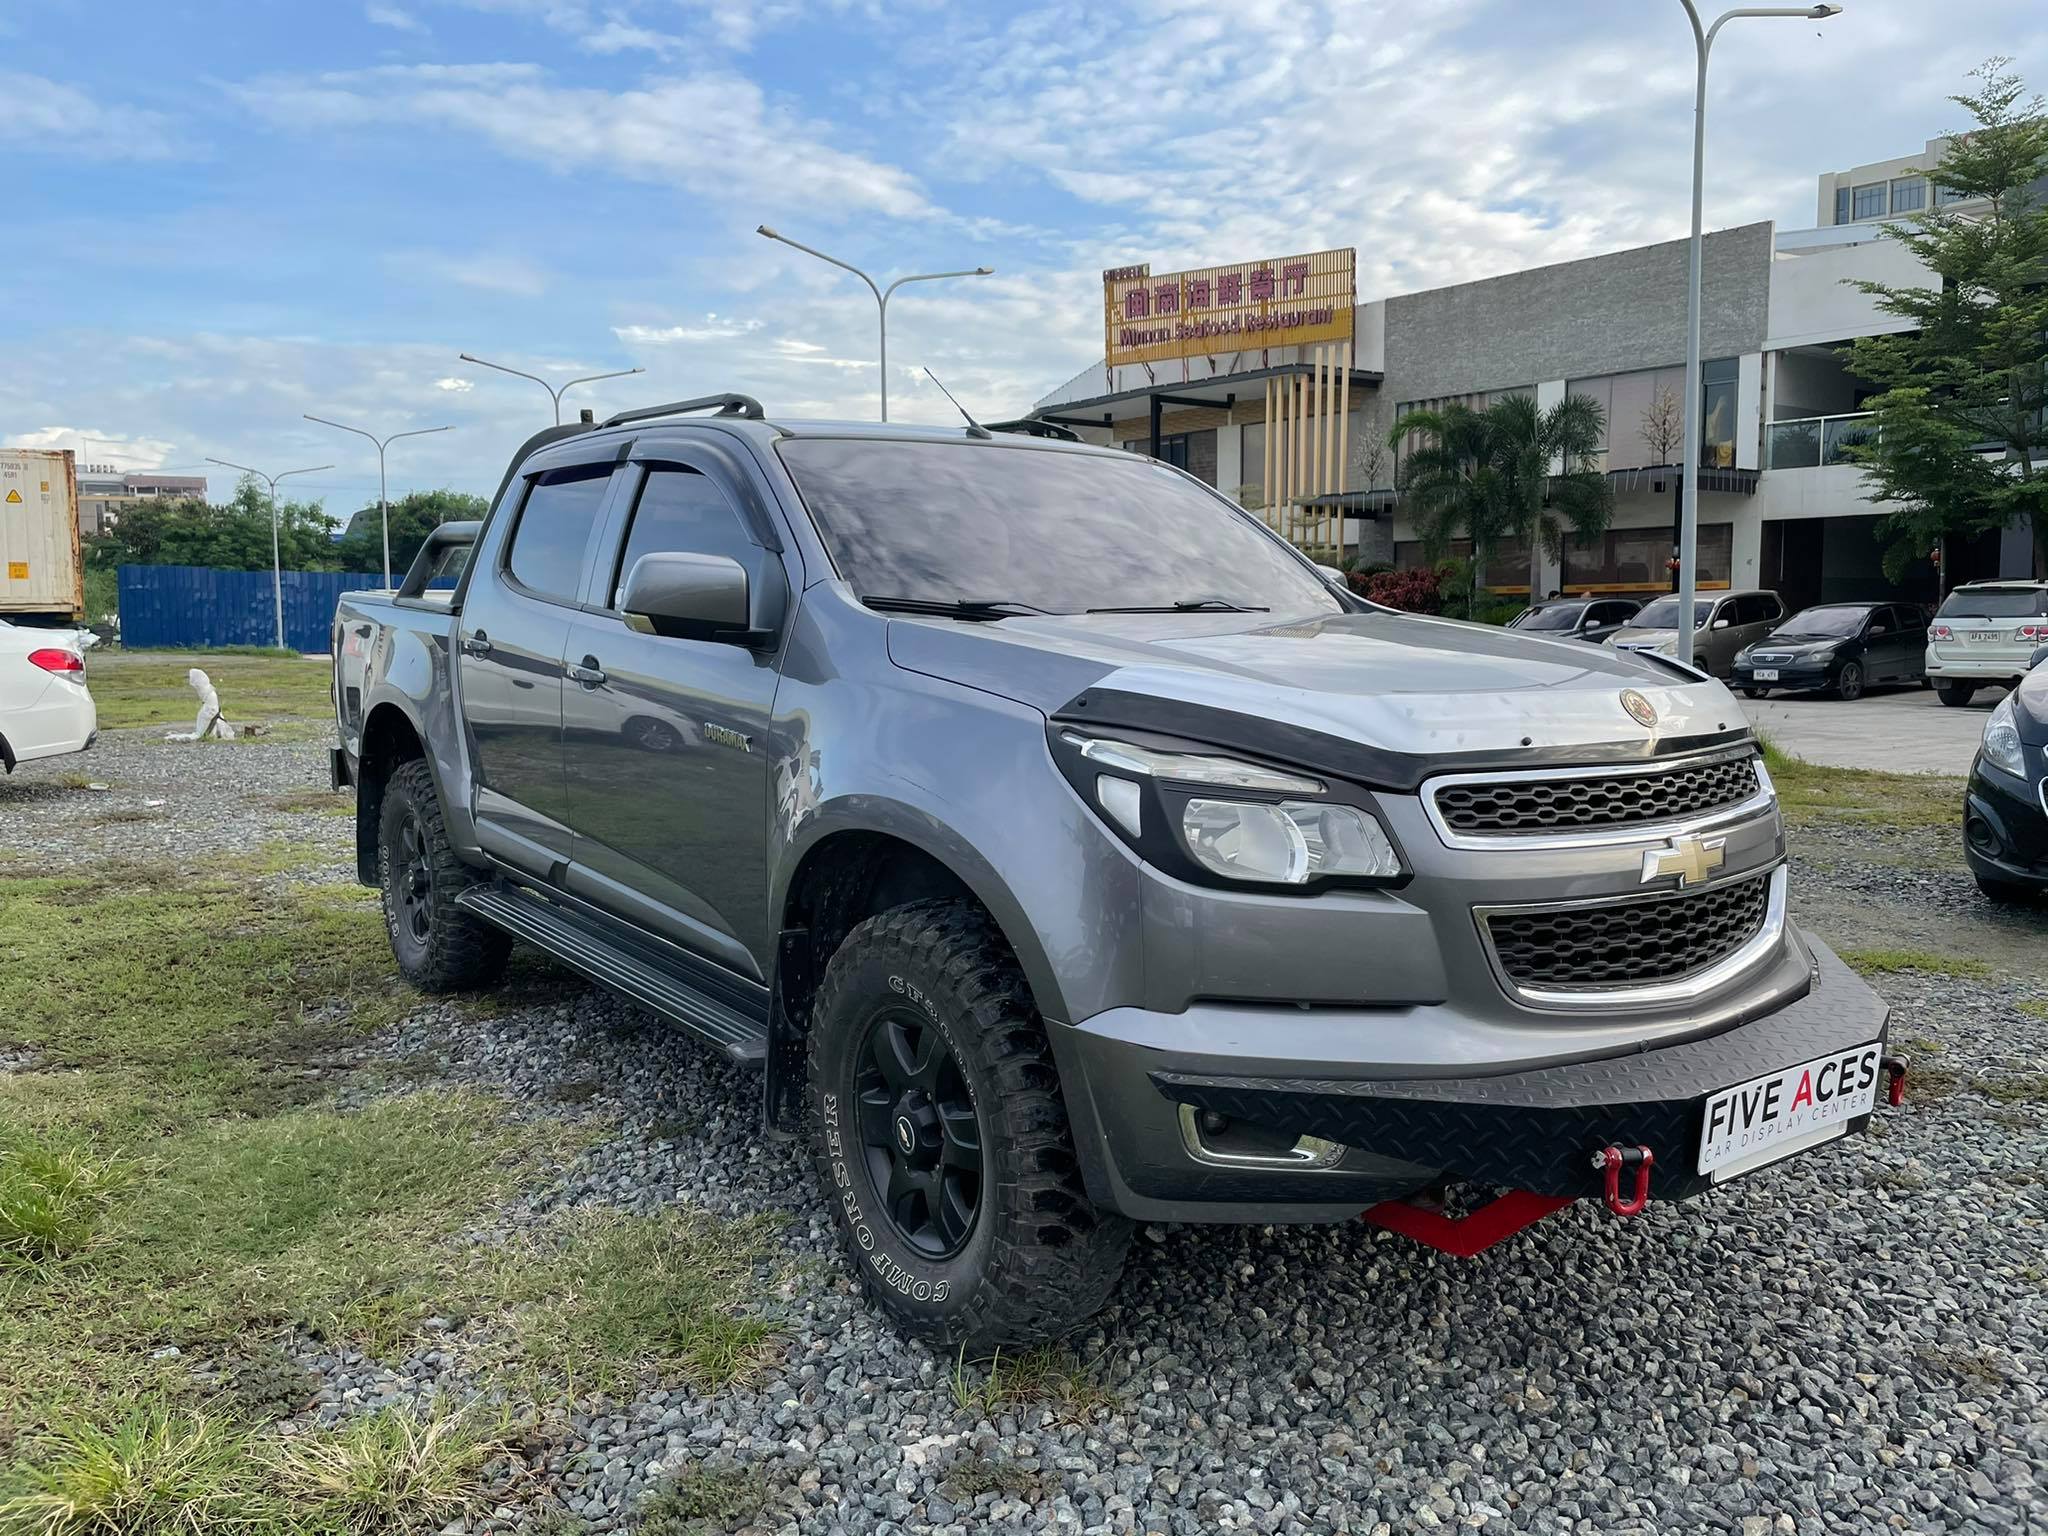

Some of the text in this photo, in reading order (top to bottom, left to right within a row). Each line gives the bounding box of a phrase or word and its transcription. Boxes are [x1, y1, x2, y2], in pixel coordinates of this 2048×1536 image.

[1120, 305, 1334, 347] Minnan Seafood Restaurant
[704, 722, 752, 752] DURAMAX
[1704, 1092, 1867, 1163] CAR DISPLAY CENTER
[1707, 1050, 1877, 1145] FIVE ACES
[823, 1094, 951, 1303] COMFORSER
